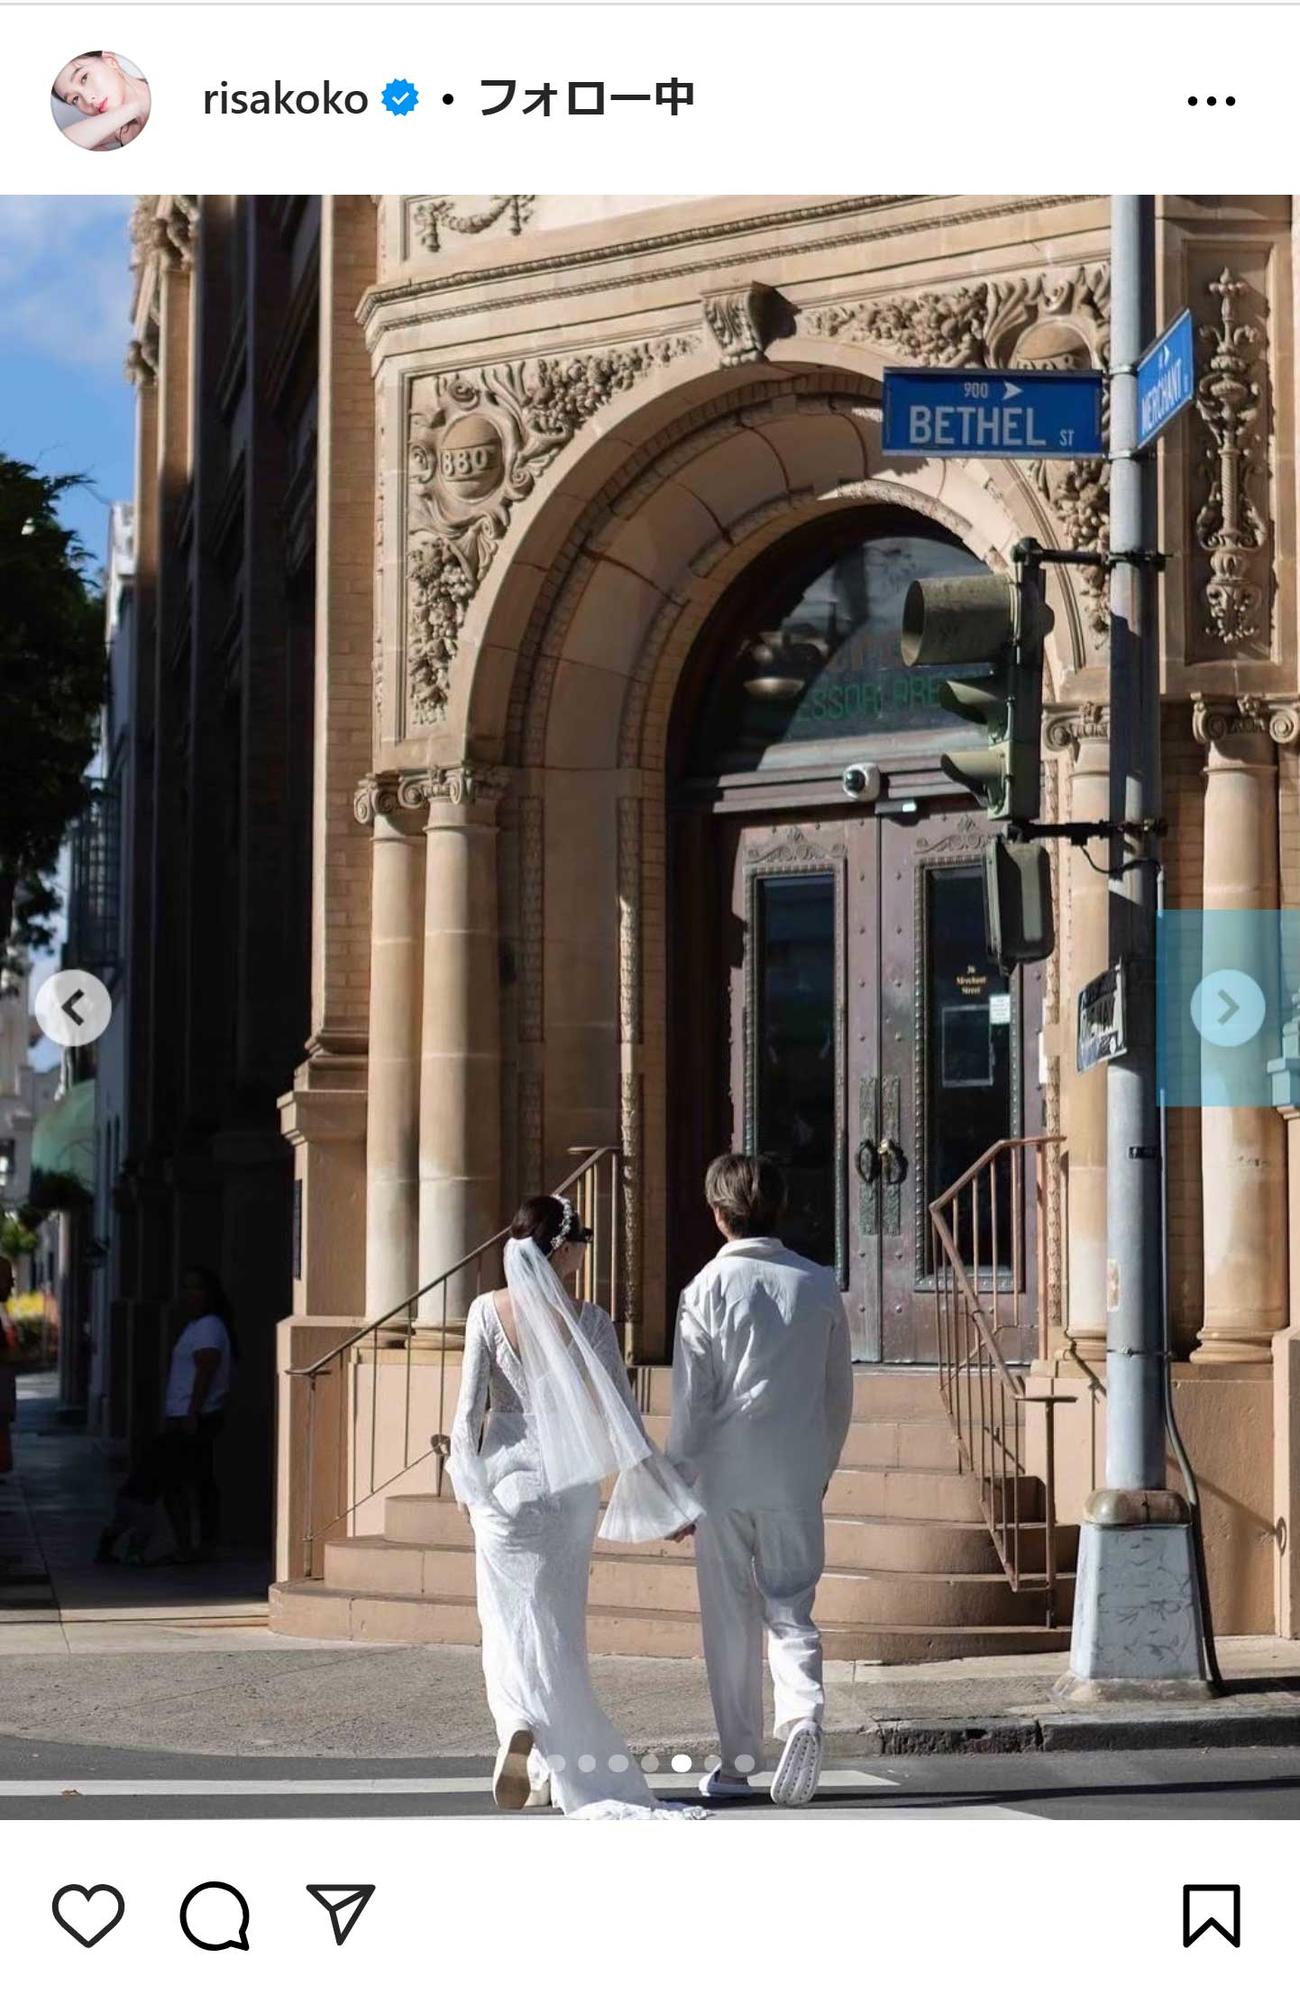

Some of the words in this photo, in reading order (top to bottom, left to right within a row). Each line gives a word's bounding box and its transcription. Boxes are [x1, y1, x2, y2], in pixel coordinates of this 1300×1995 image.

[965, 383, 987, 397] 900
[1141, 357, 1182, 437] MERCHANT
[909, 405, 1047, 446] BETHEL
[1059, 429, 1075, 447] ST
